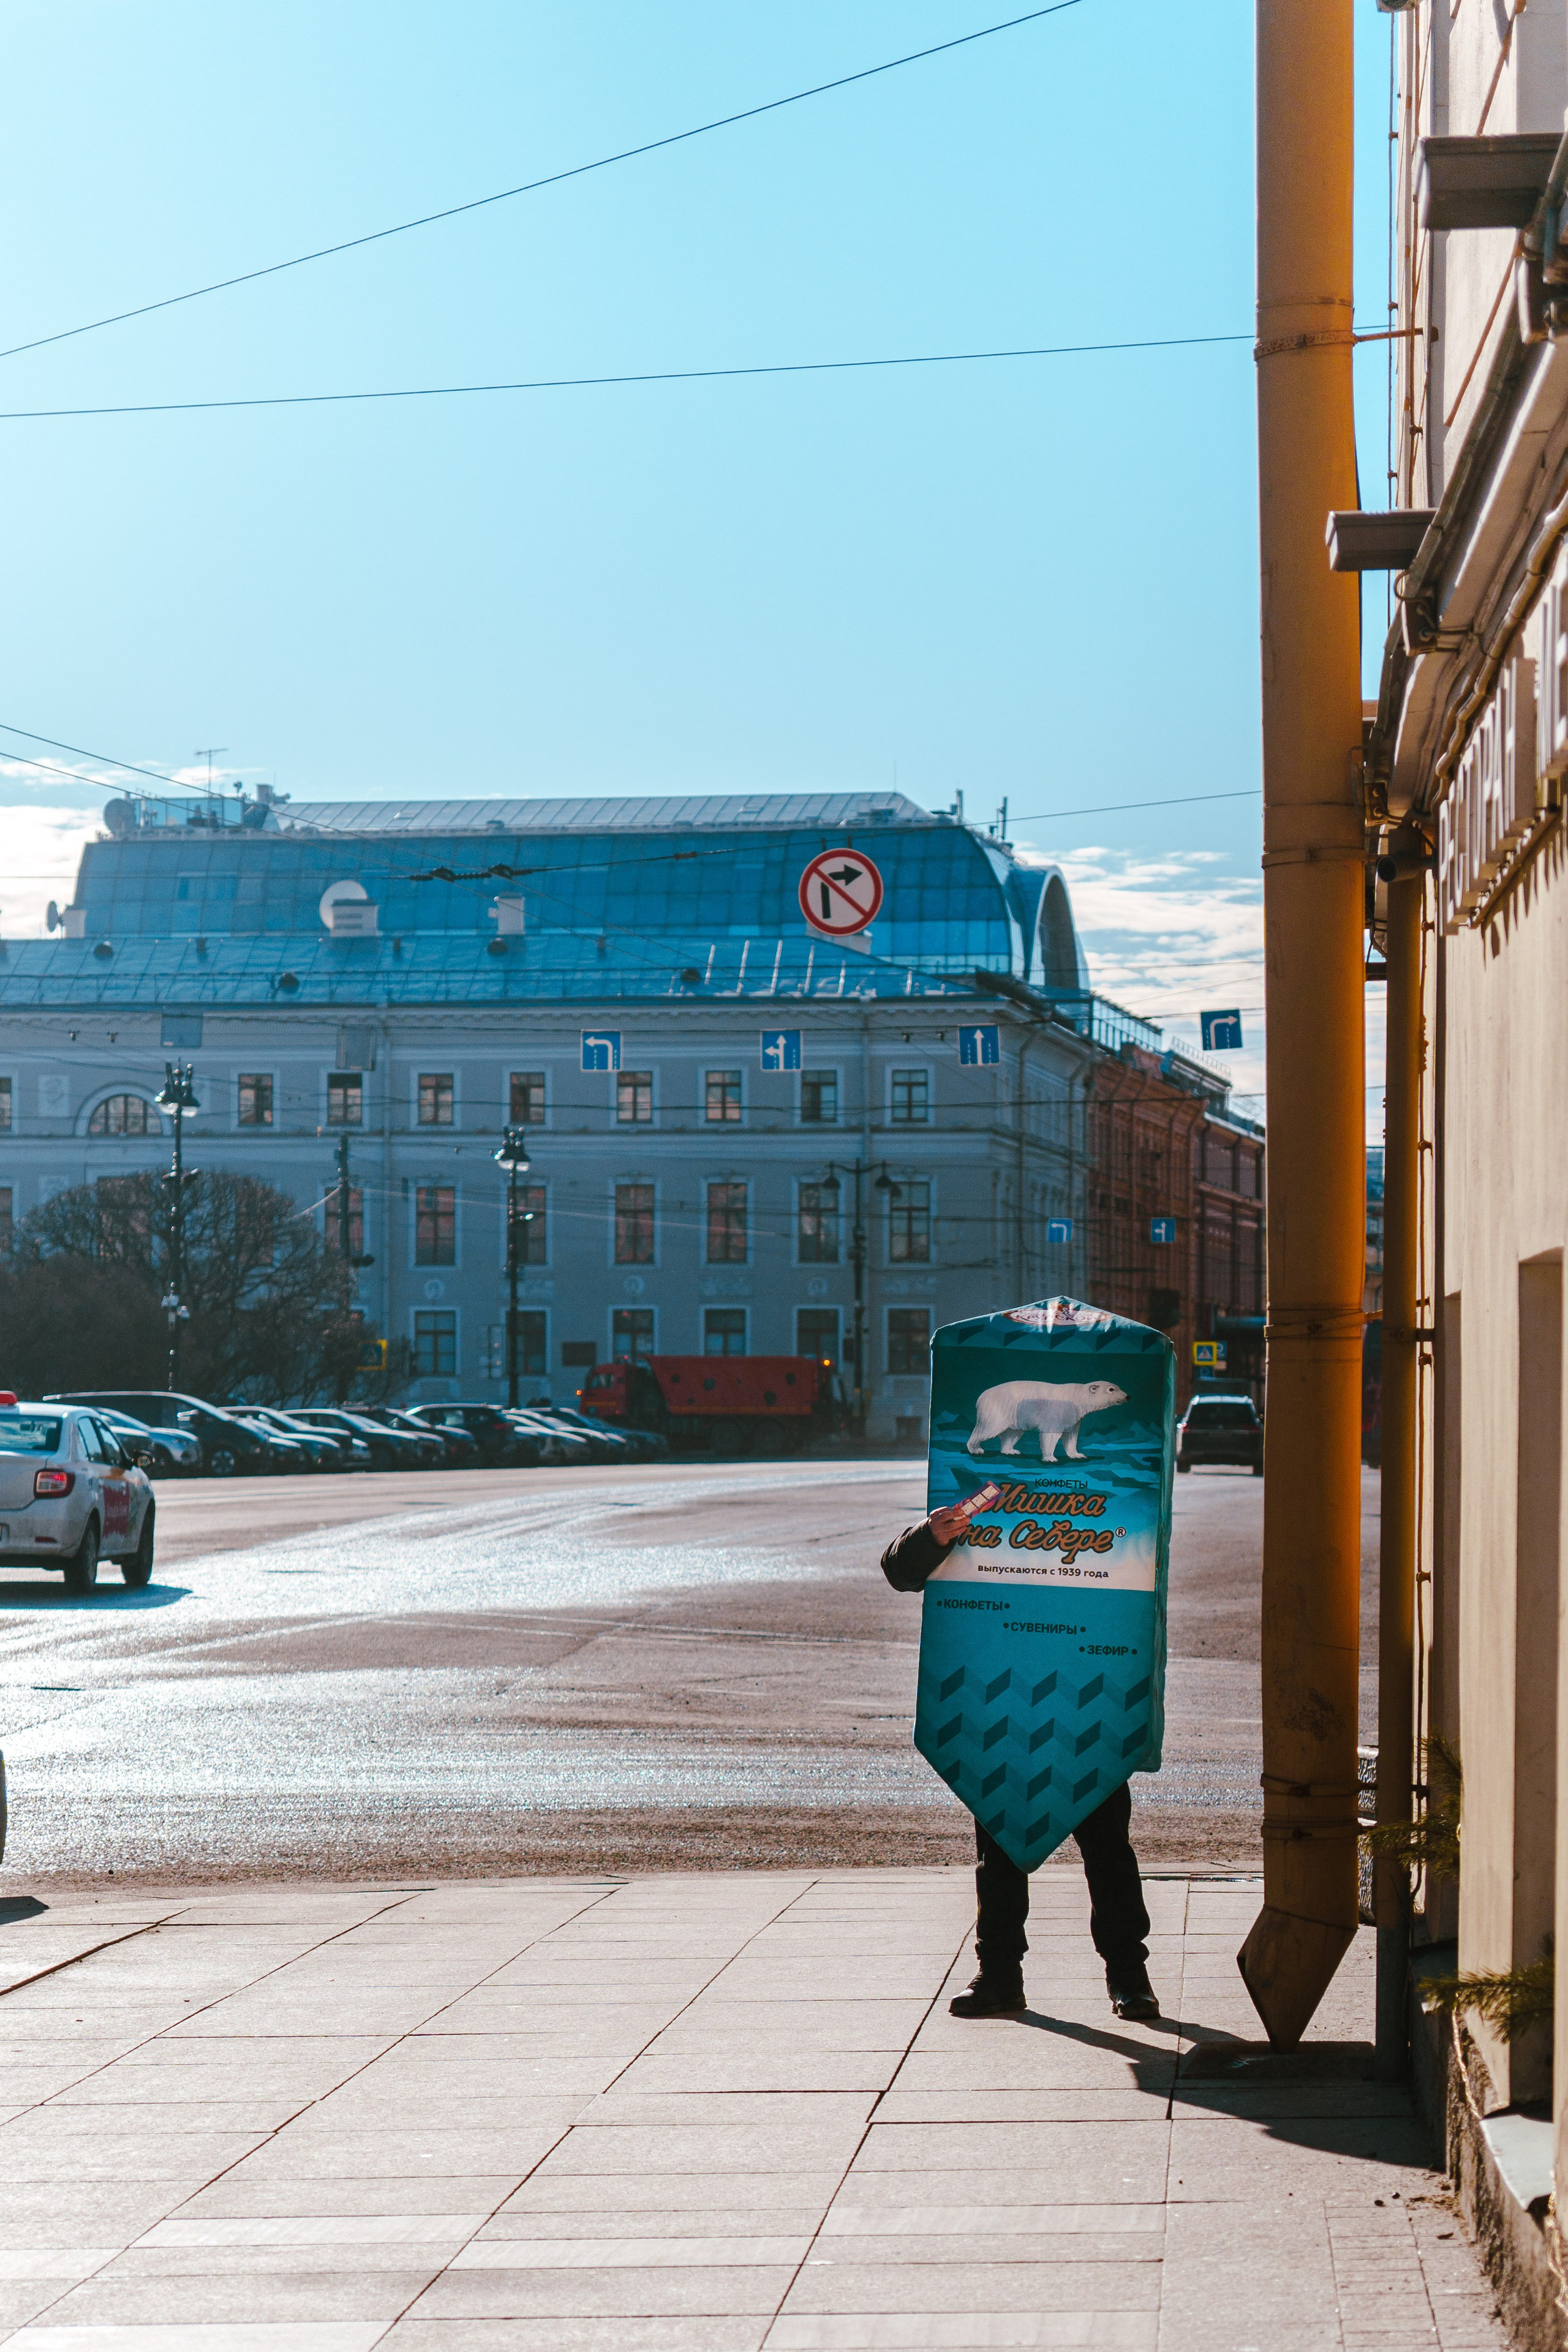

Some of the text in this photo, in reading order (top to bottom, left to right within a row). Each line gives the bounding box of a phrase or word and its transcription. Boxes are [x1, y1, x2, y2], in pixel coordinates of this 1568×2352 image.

[1439, 657, 1517, 937] РЕСТОРАН
[1035, 1478, 1088, 1490] КОНФЕТЫ
[958, 1523, 1003, 1548] на
[978, 1565, 1047, 1575] выпускаются
[1058, 1567, 1081, 1577] 1939
[943, 1599, 1003, 1611] КОНФЕТЫ
[1011, 1622, 1077, 1635] СУВЕНИРЫ
[1087, 1645, 1129, 1656] ЗЕФИР
